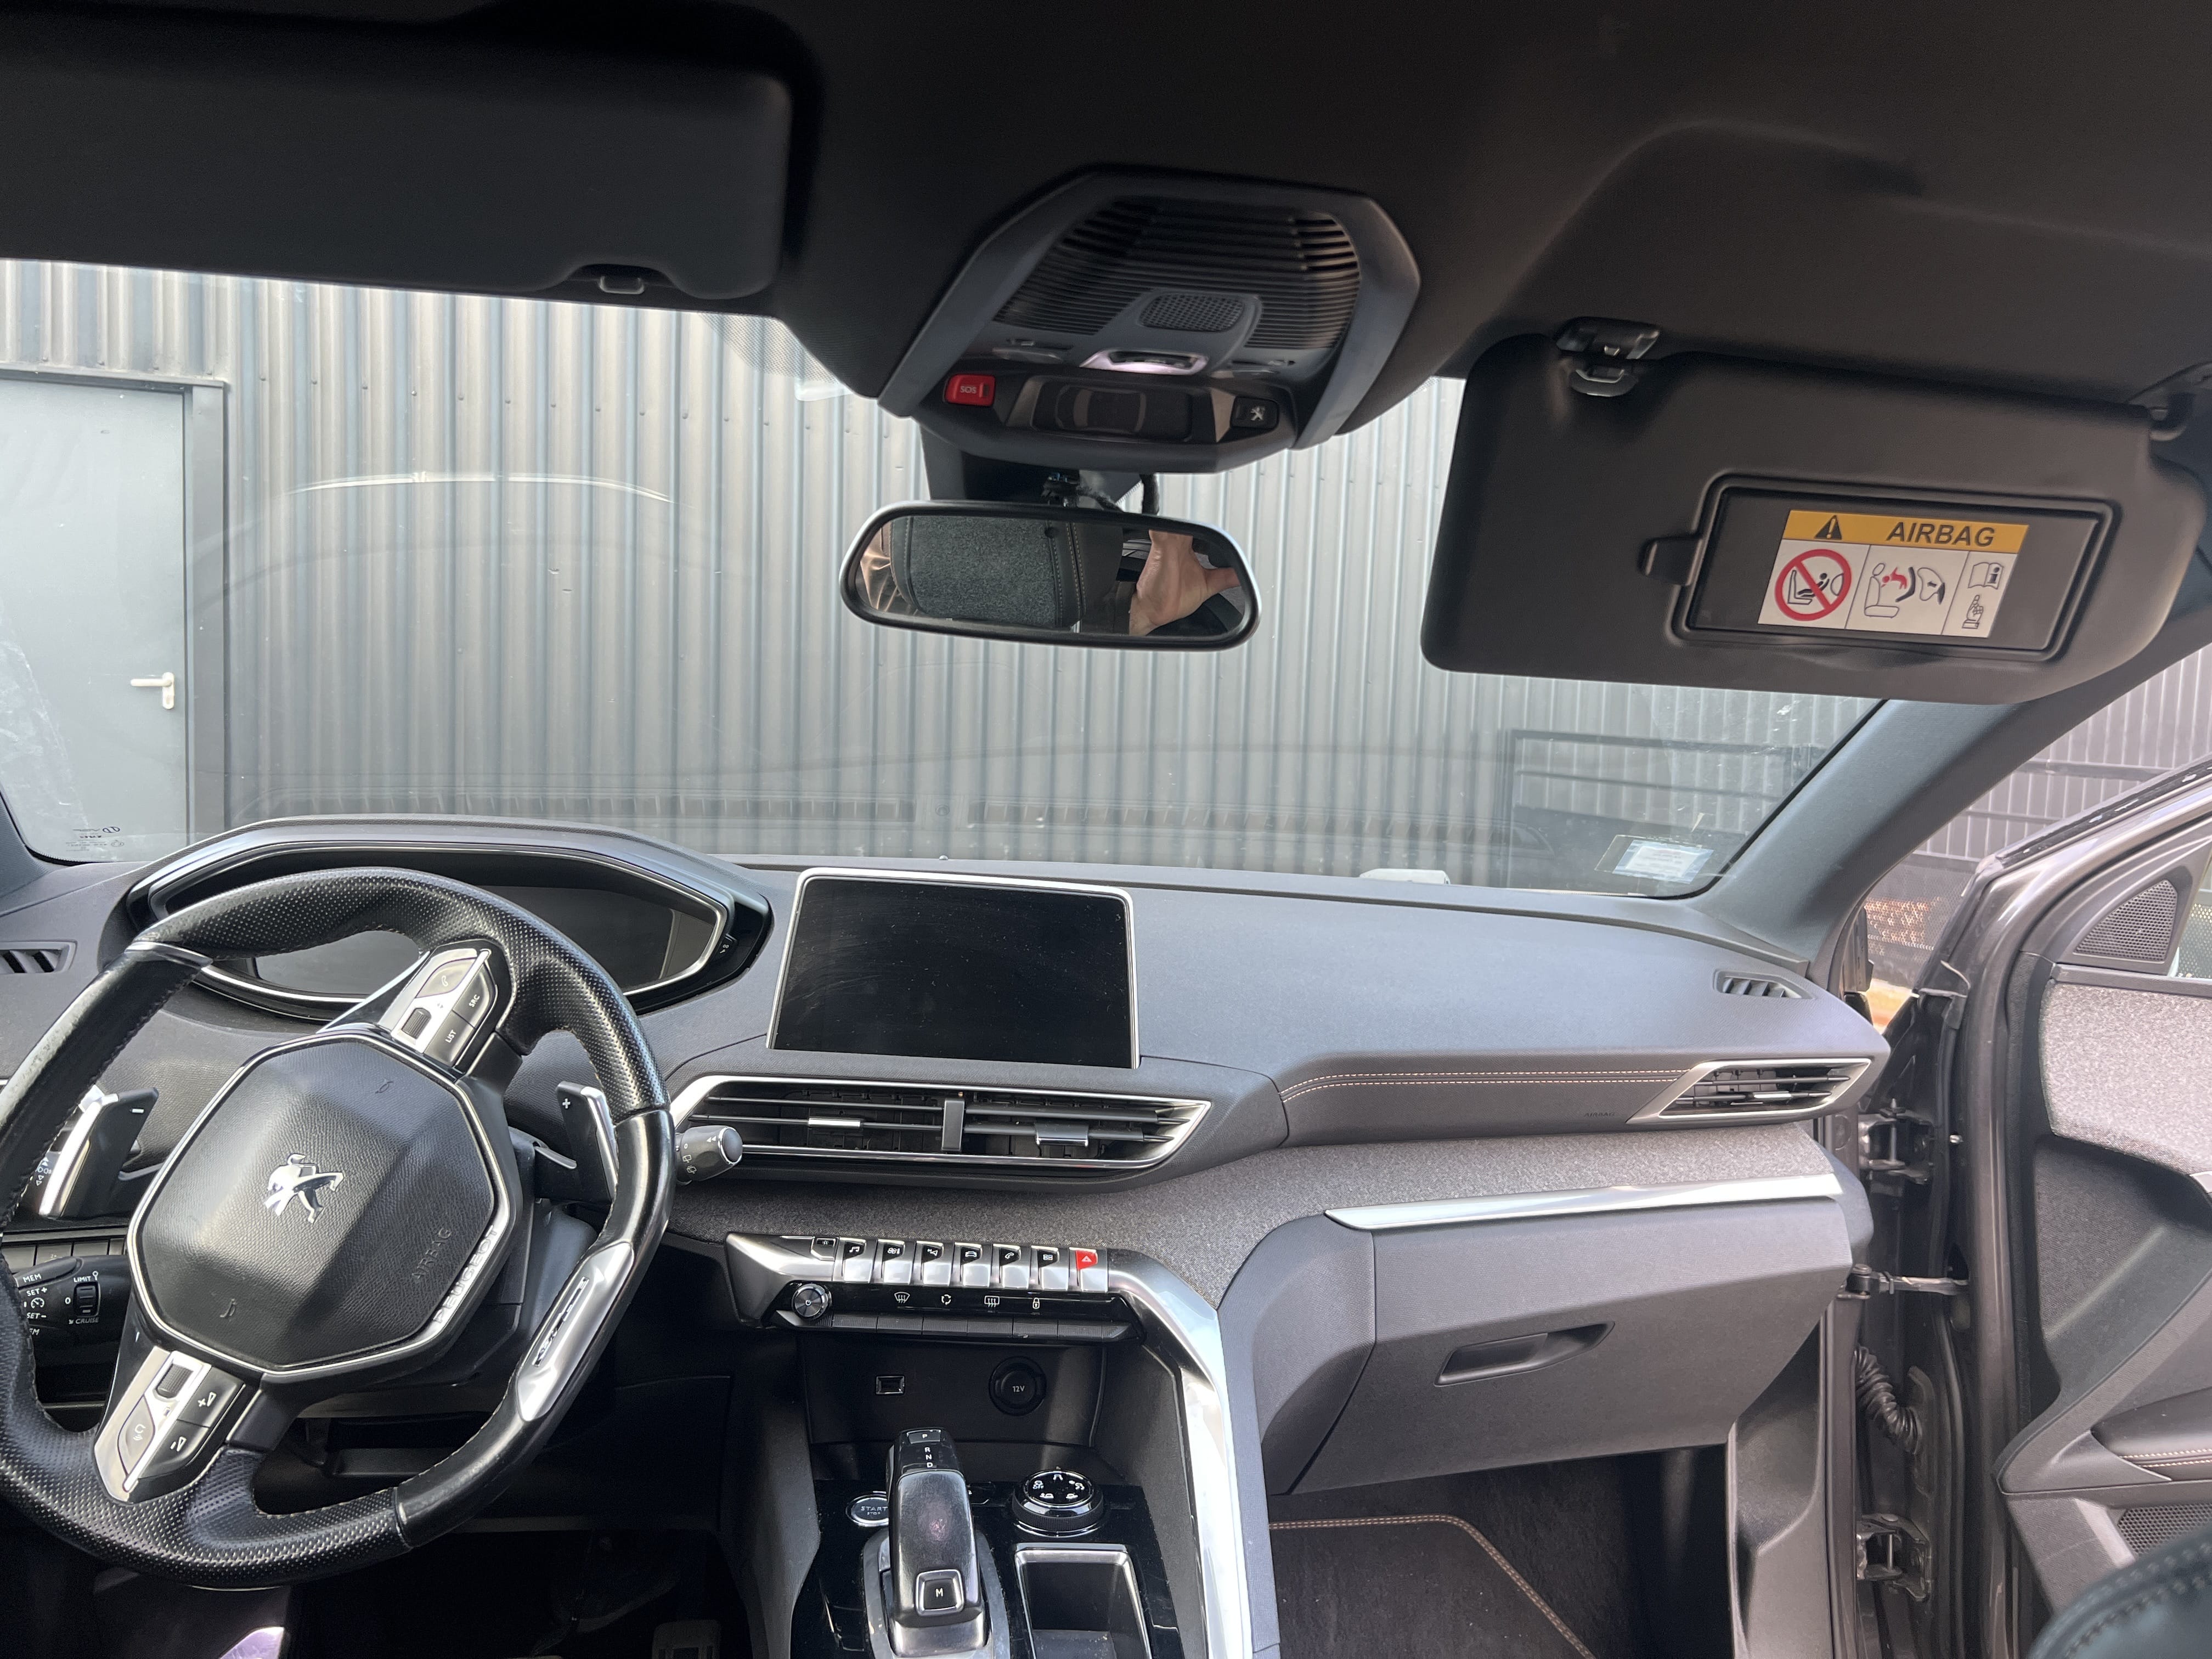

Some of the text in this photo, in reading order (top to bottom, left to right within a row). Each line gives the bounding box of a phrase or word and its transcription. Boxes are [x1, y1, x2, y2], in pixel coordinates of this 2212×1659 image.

[960, 385, 977, 394] SOS
[1886, 522, 1995, 547] AIRBAG
[469, 994, 480, 1008] SRC
[445, 1029, 456, 1043] LIST
[22, 1273, 42, 1283] MEM
[935, 1588, 943, 1597] M
